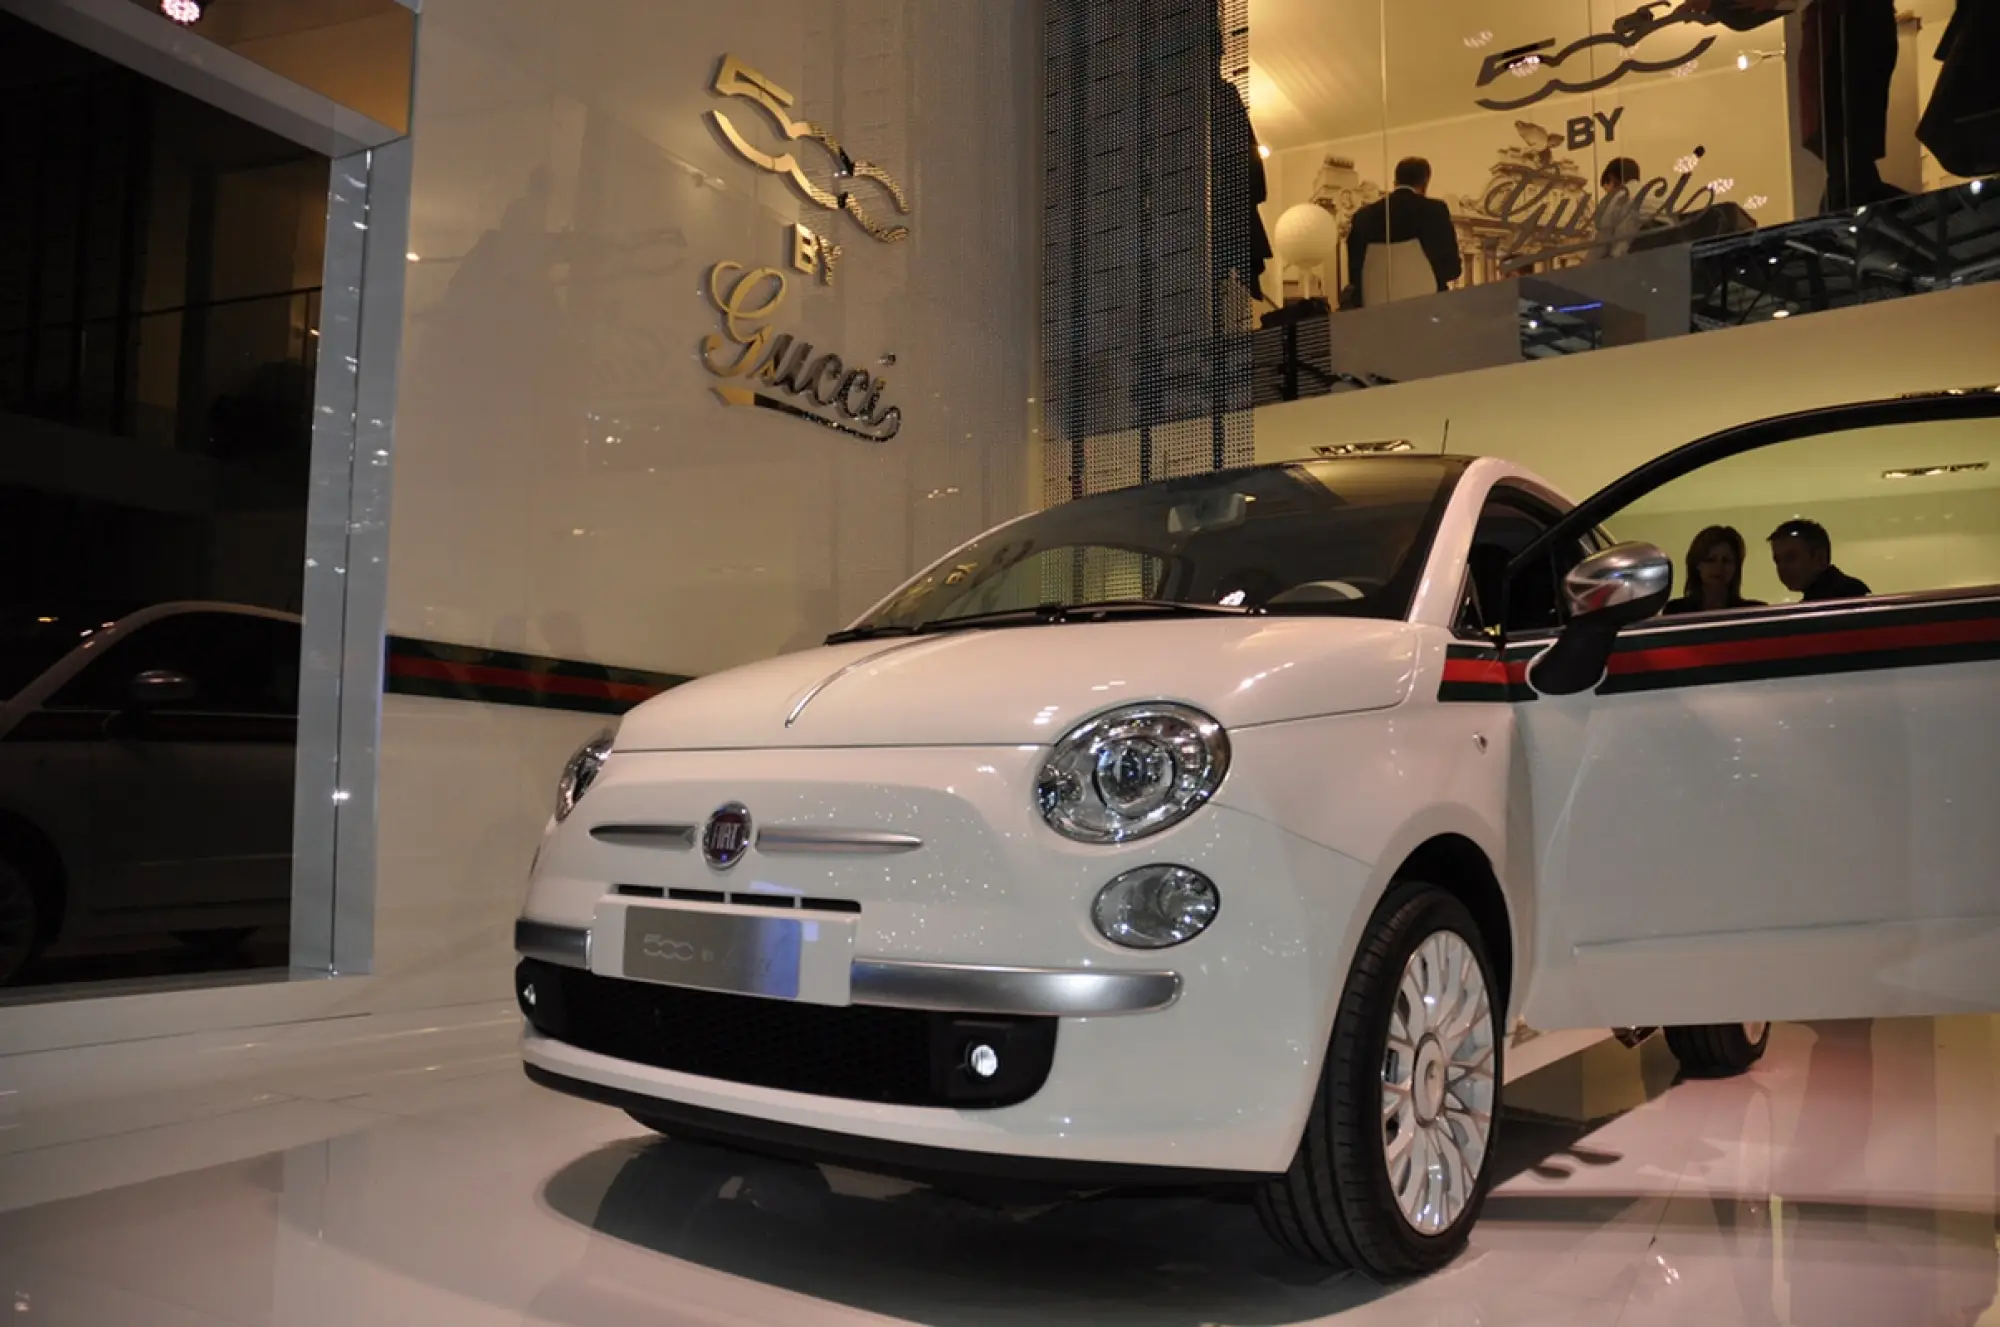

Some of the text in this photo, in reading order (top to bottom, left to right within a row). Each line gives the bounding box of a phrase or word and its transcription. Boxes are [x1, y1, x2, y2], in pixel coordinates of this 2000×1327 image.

[1474, 10, 1717, 111] 500
[707, 53, 910, 243] 500
[1566, 107, 1624, 151] BY
[1484, 144, 1717, 273] Gucci
[791, 222, 843, 287] BY
[701, 260, 901, 442] Gucci
[711, 822, 741, 849] FIAT
[643, 933, 694, 961] 500
